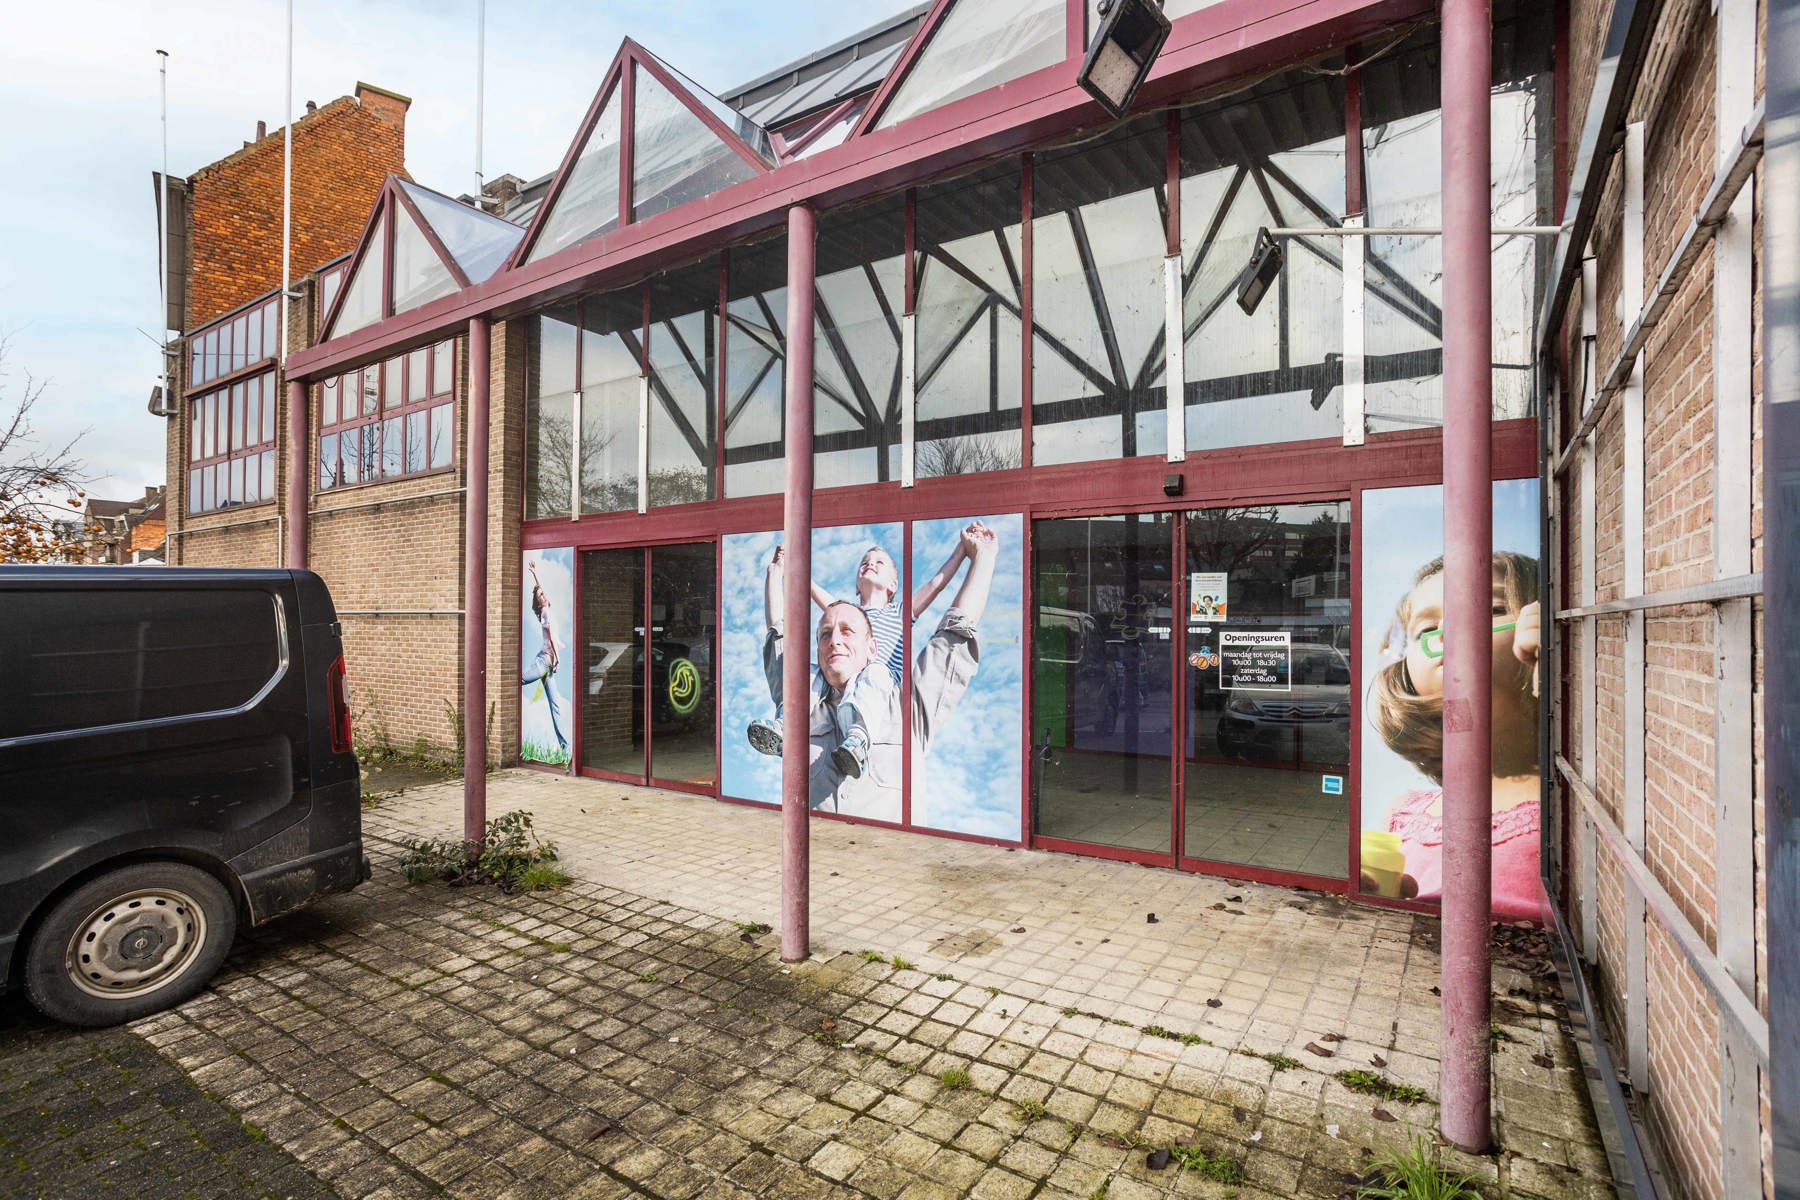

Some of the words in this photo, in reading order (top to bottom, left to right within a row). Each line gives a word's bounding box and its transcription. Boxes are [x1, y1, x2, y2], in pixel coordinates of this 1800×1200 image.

[1224, 633, 1285, 644] Openingsuren
[1223, 651, 1252, 660] maandag
[1263, 651, 1285, 660] vrijdag
[1240, 668, 1267, 676] zaterdag
